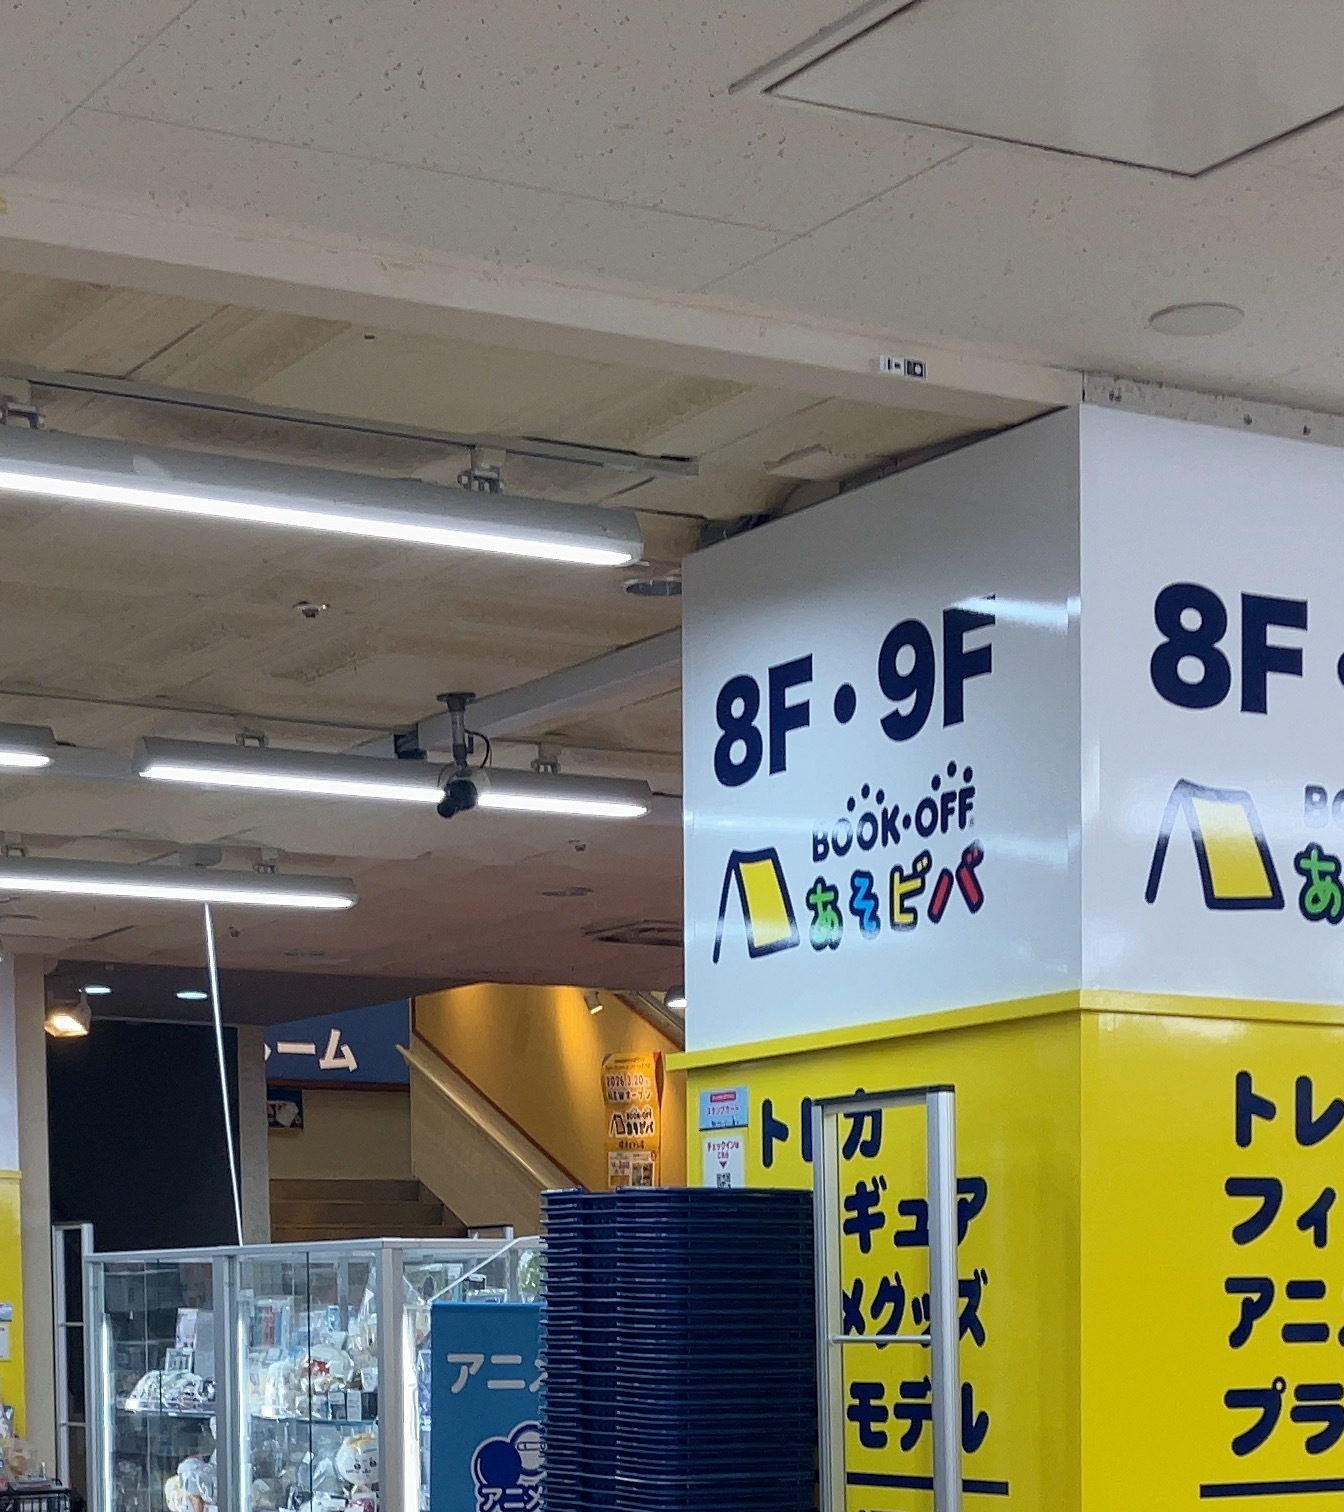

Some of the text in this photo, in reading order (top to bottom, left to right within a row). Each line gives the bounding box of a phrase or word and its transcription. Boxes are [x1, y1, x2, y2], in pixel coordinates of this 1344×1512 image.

[805, 838, 986, 951] あそビバ
[264, 1027, 358, 1072] ーム
